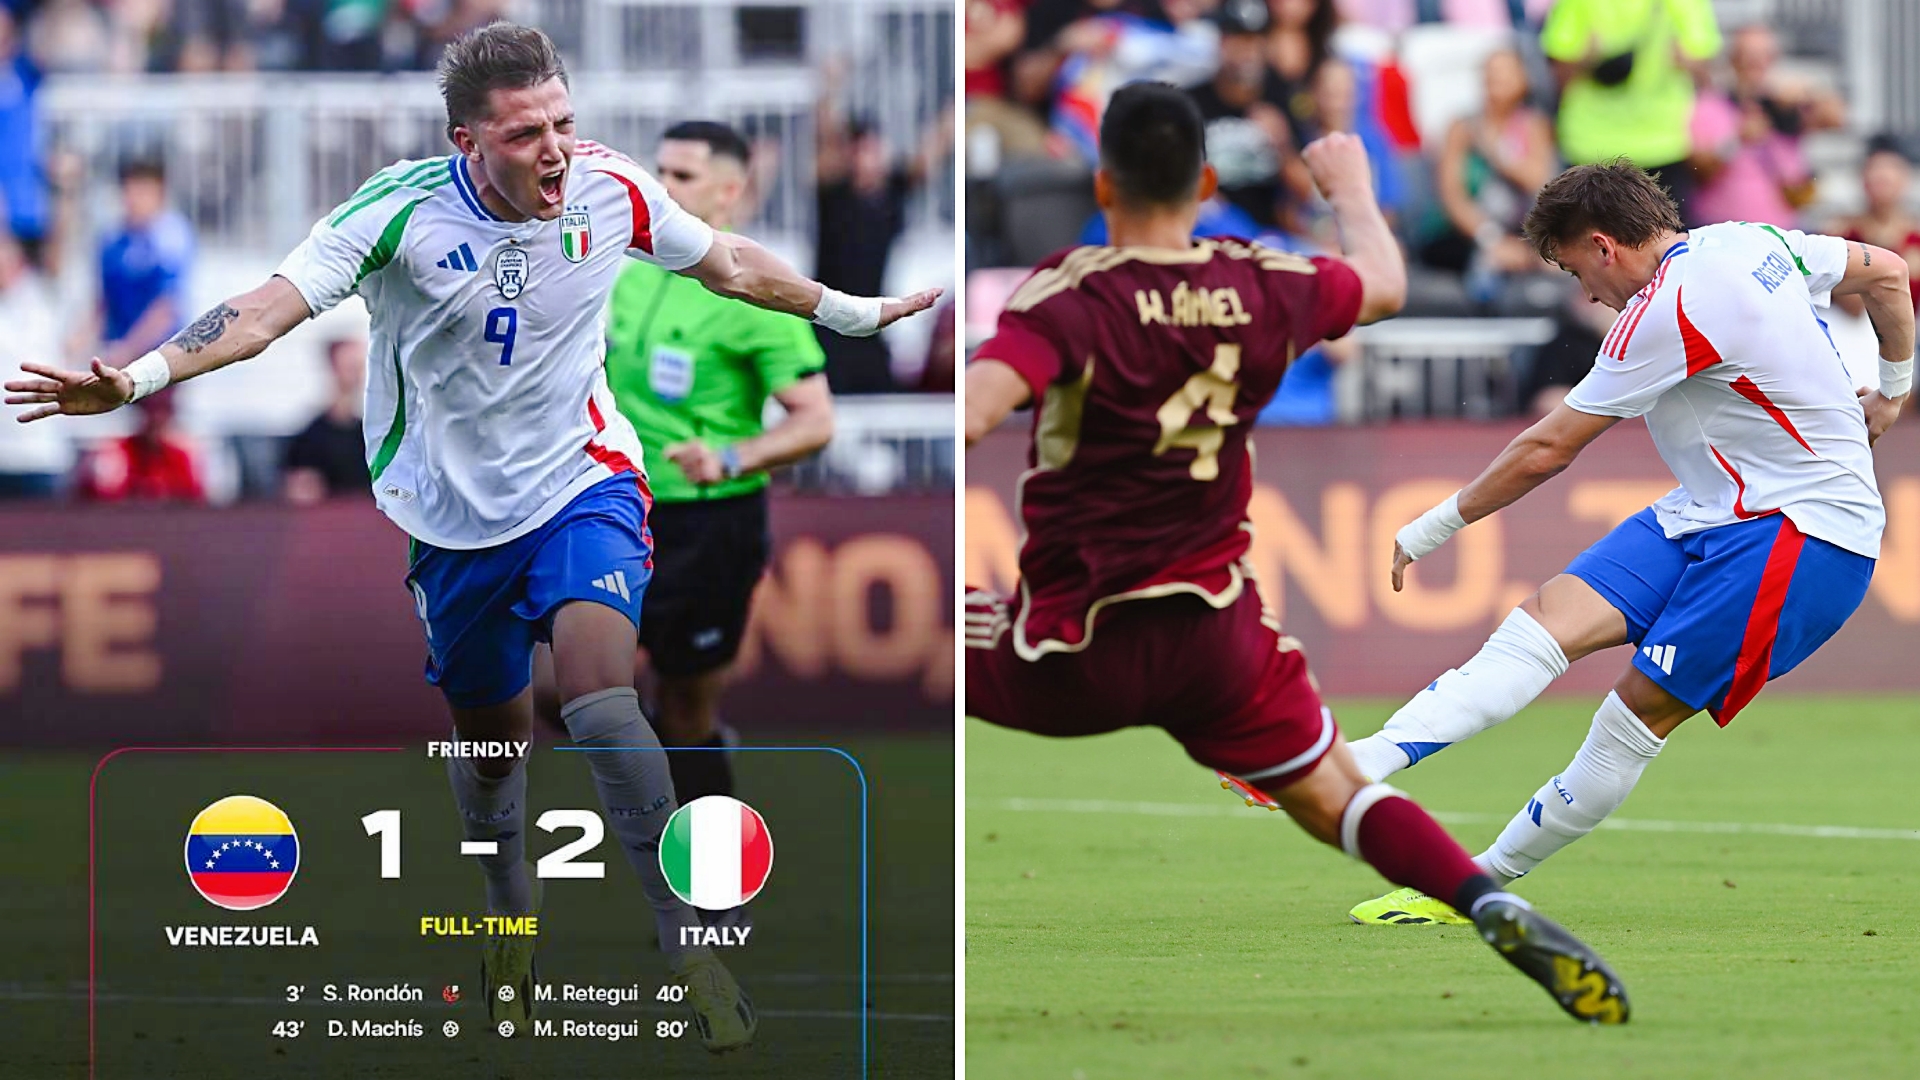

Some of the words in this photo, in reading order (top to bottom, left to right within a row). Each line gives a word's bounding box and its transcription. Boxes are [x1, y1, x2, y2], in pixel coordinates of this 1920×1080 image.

[561, 216, 588, 227] ITALIA
[1751, 250, 1794, 294] RETEGU
[484, 306, 517, 366] 9
[1153, 343, 1242, 481] 4
